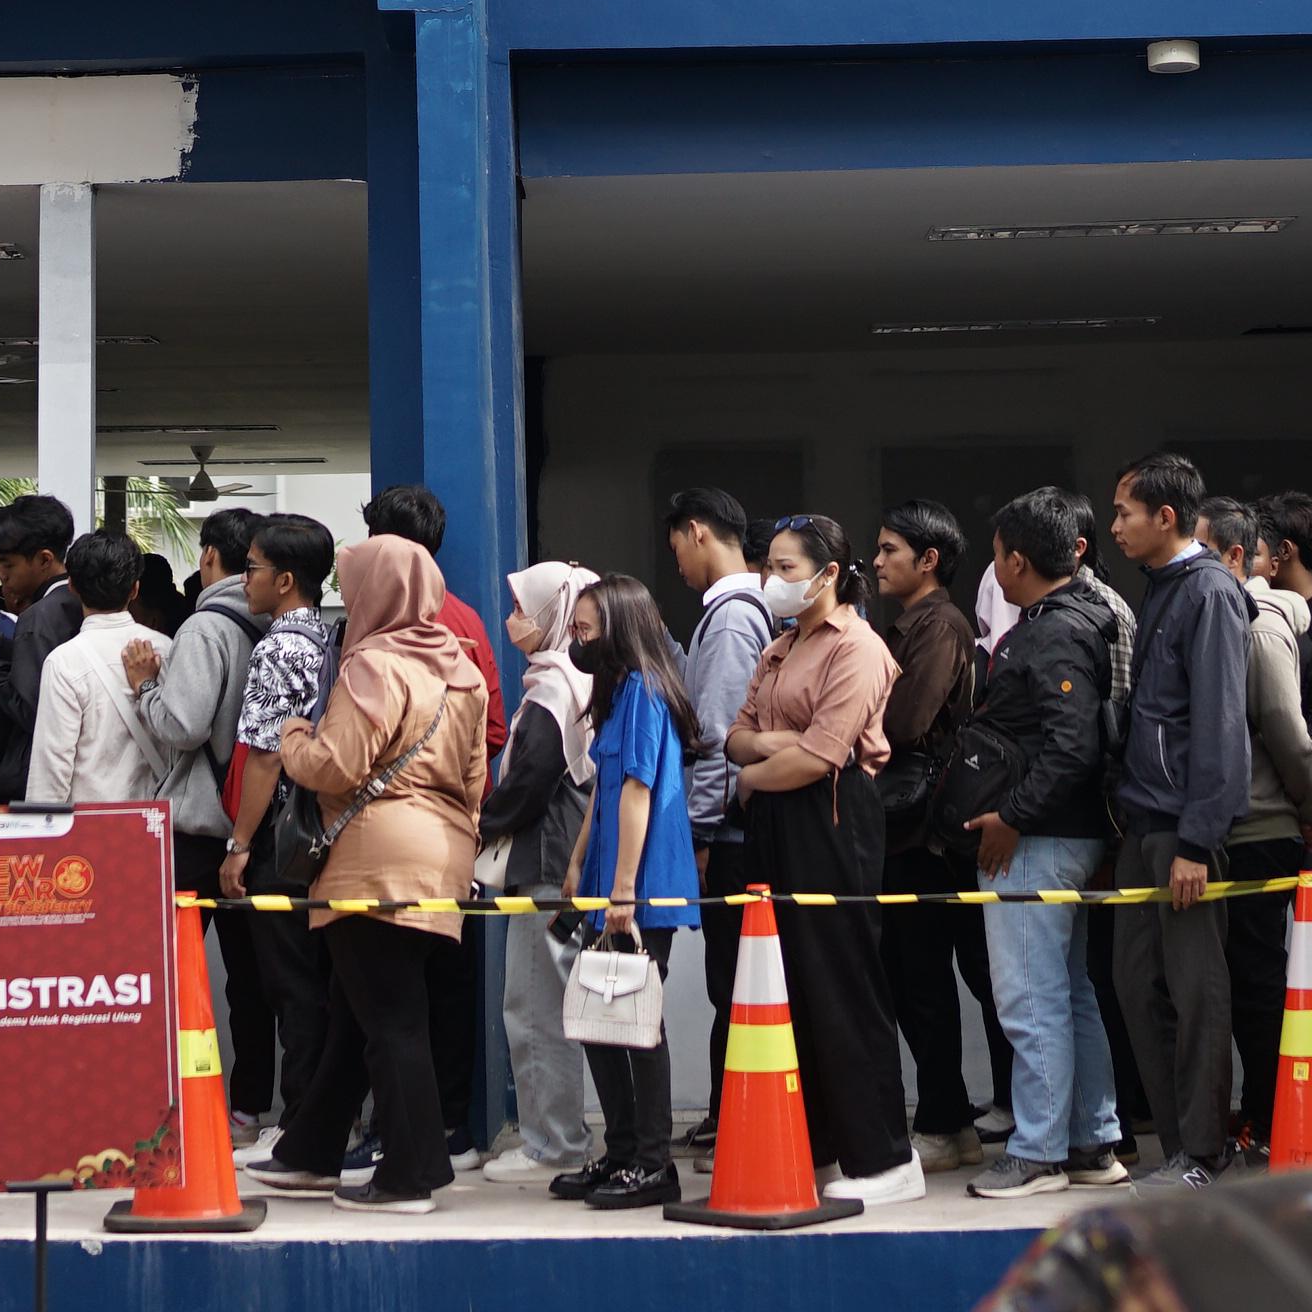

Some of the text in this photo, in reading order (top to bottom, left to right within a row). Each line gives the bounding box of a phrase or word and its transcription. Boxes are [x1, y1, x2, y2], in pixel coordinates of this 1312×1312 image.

[29, 1014, 60, 1026] Untuk
[60, 1012, 111, 1026] Registrasi
[112, 1011, 143, 1024] Ulang
